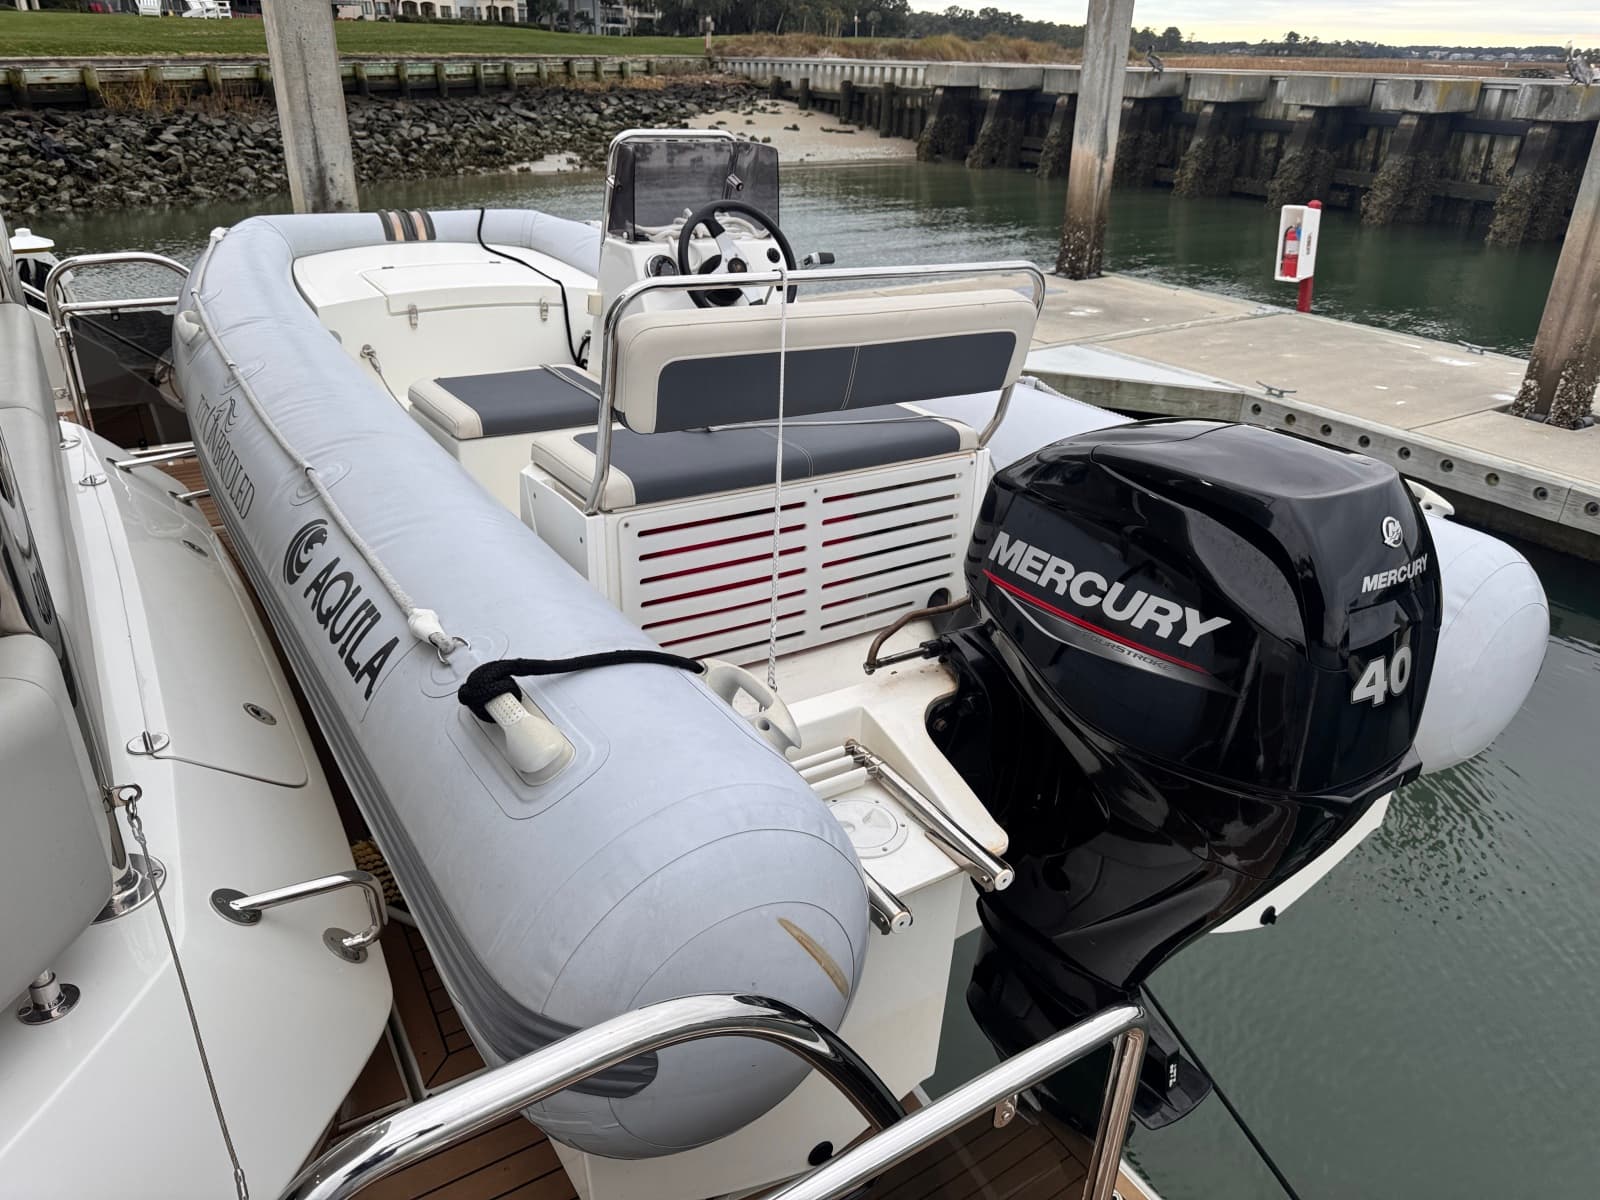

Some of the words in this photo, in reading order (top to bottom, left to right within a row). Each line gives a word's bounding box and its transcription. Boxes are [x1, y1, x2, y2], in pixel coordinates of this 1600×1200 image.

[203, 406, 255, 520] UNBRIDLED
[303, 557, 400, 700] AQUILA
[988, 531, 1231, 647] MERCURY
[1361, 553, 1428, 593] MERCURY
[1351, 646, 1412, 708] 40
